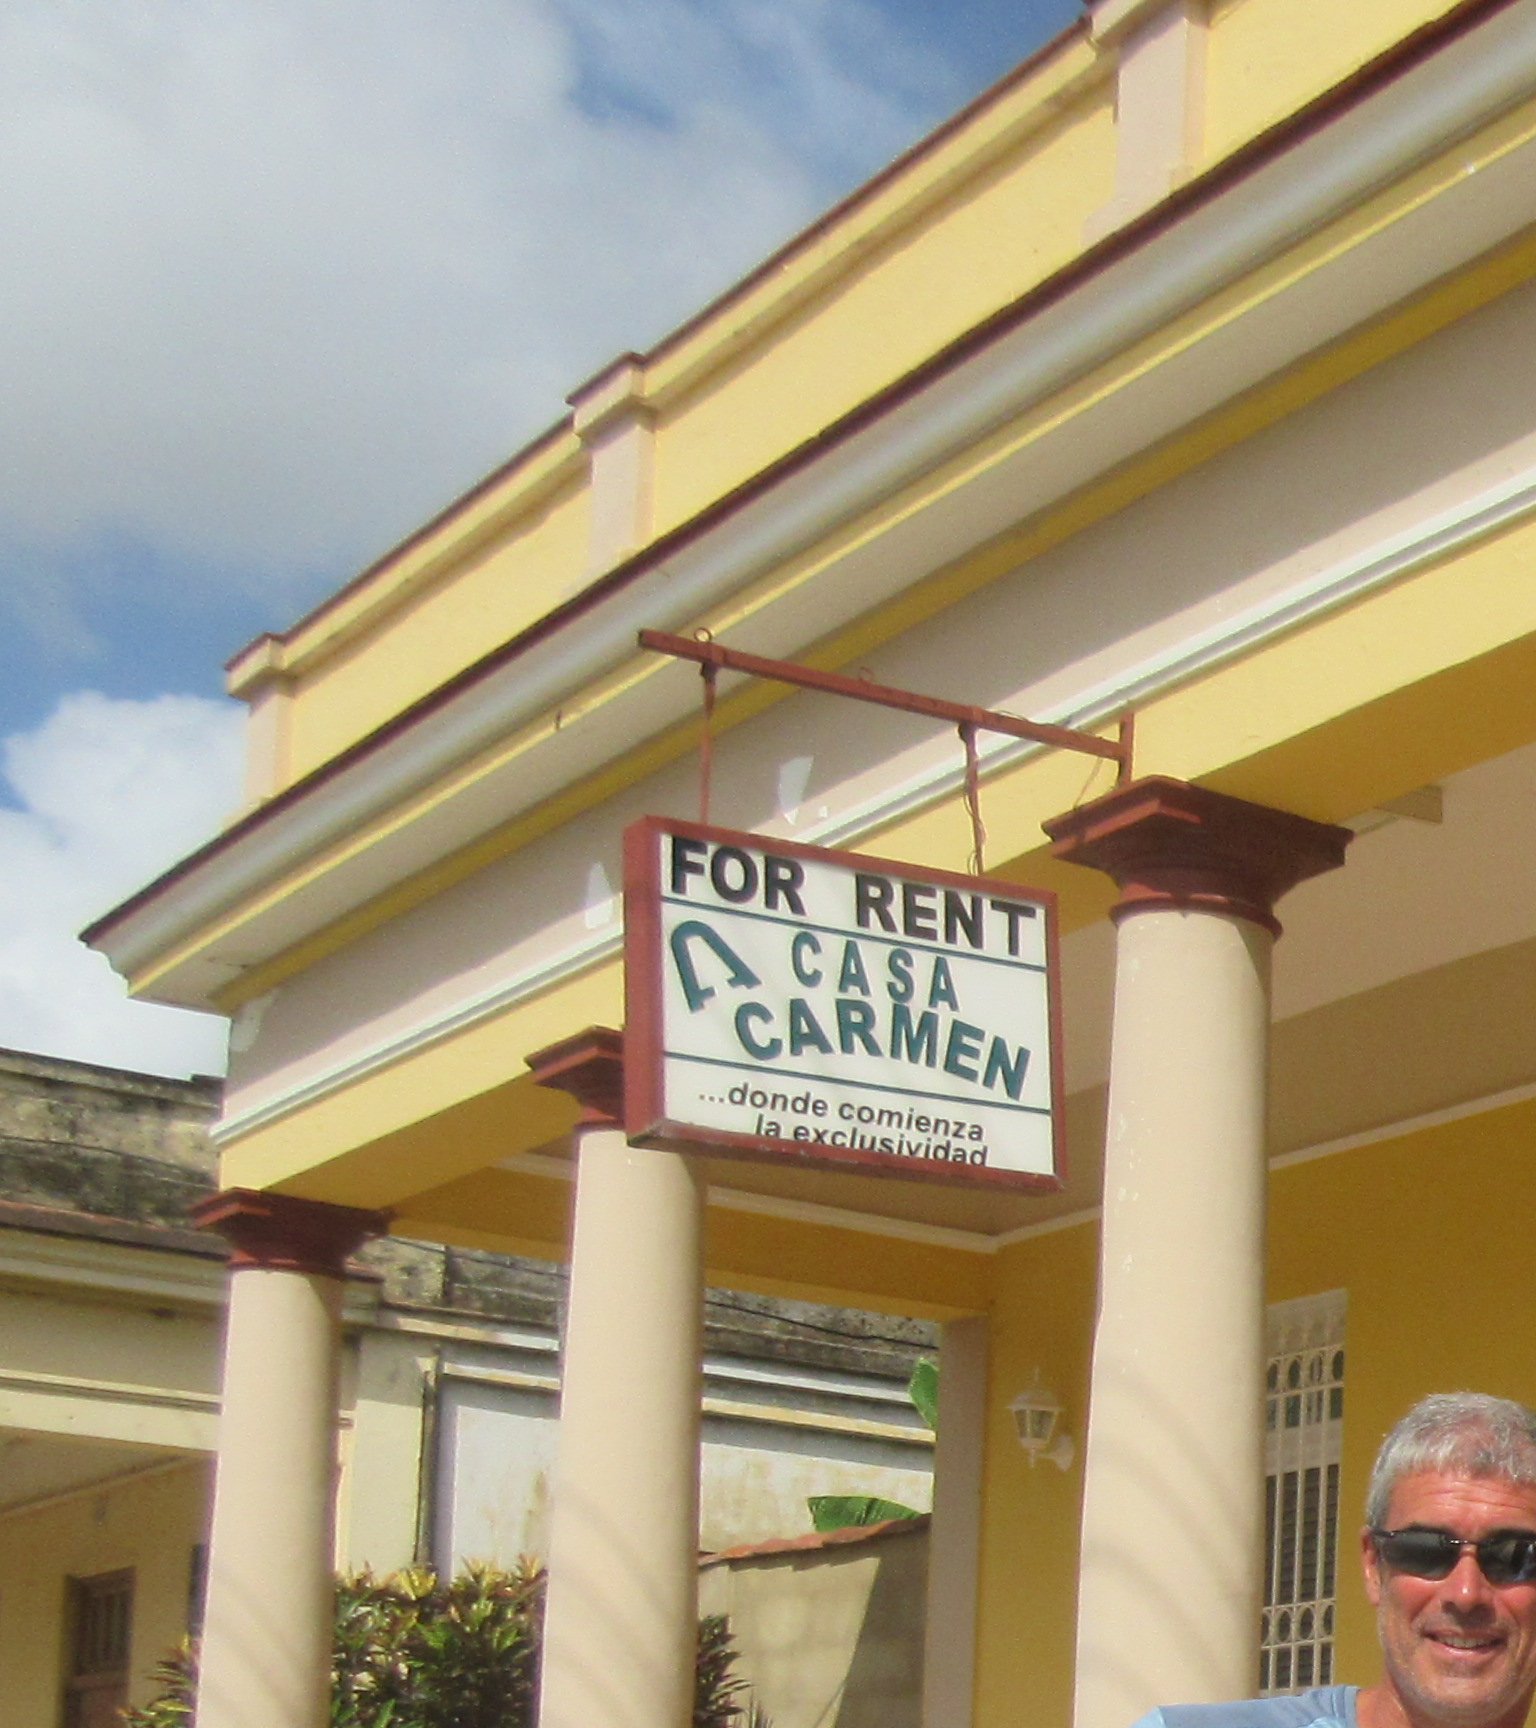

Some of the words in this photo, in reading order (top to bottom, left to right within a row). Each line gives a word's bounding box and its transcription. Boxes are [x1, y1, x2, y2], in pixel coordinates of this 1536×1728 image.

[671, 836, 806, 916] FOR
[855, 873, 1036, 957] RENT
[791, 931, 959, 1012] CASA
[734, 998, 1031, 1101] CARMEN
[755, 1113, 781, 1139] la
[793, 1124, 988, 1167] exclusividad
[838, 1102, 984, 1142] comienza
